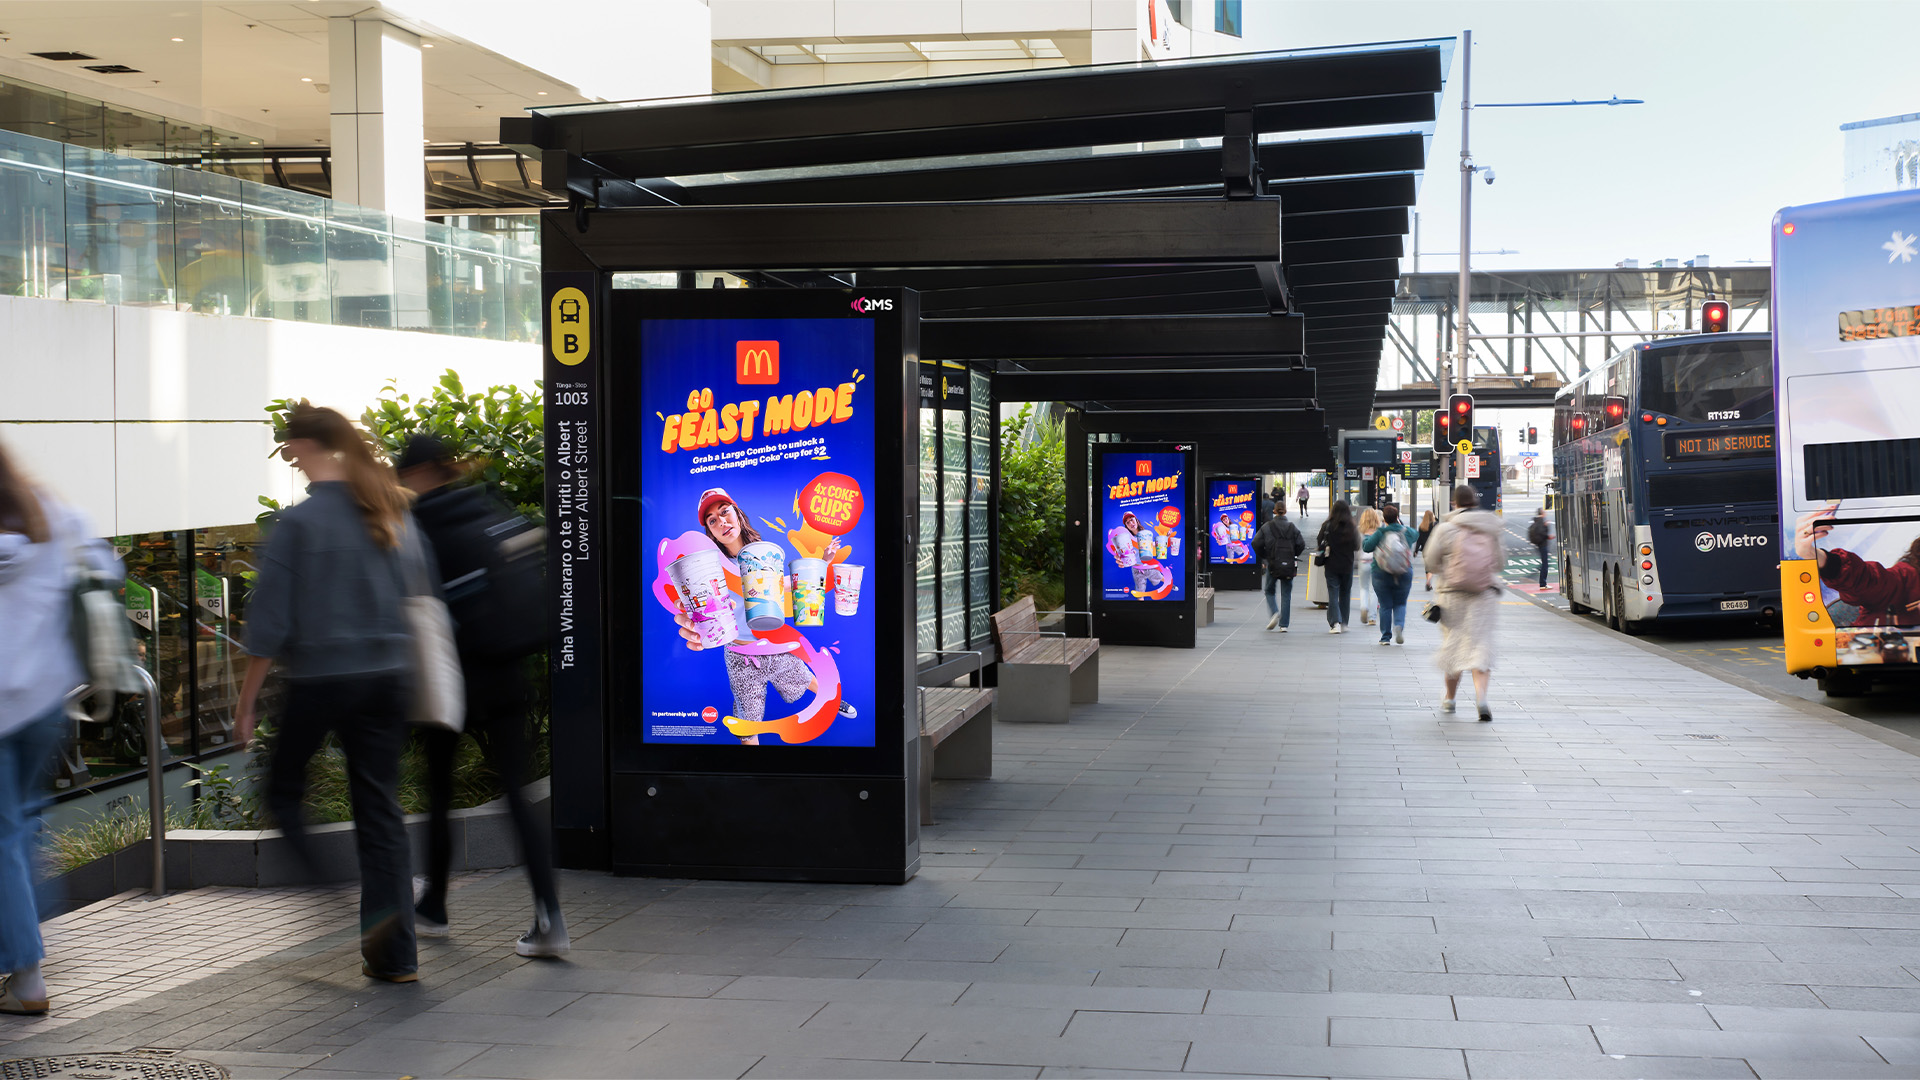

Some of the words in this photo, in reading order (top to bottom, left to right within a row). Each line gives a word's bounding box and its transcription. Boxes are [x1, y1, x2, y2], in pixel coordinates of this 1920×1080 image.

[858, 297, 893, 313] QMS
[1874, 307, 1908, 323] Join
[1845, 323, 1888, 340] 0800
[564, 334, 579, 353] B
[555, 392, 588, 405] 1003
[687, 387, 714, 412] GO
[661, 400, 760, 454] FEAST
[763, 382, 856, 437] MODE
[1707, 410, 1740, 420] RT1375
[558, 420, 571, 466] Albert
[575, 420, 588, 464] Street
[693, 452, 713, 464] Grab
[721, 450, 745, 460] Large
[746, 445, 776, 456] Combo
[778, 443, 787, 451] to
[789, 437, 817, 449] unlock
[1461, 443, 1468, 451] B
[1680, 439, 1701, 453] NOT
[1707, 438, 1719, 451] IN
[1724, 435, 1771, 451] SERVICE
[690, 457, 758, 475] colour-changing
[784, 450, 800, 461] cup
[801, 448, 813, 457] for
[814, 446, 827, 456] $2
[561, 470, 571, 480] o
[575, 467, 588, 512] Albert
[814, 482, 827, 496] 4x
[1109, 481, 1145, 500] FEAST
[1145, 475, 1178, 494] MODE
[558, 484, 571, 517] Tiriti
[810, 495, 852, 521] CUPS
[560, 521, 572, 535] te
[821, 516, 843, 527] COLLECT
[562, 539, 572, 549] o
[576, 516, 589, 560] Lower
[1717, 533, 1767, 548] Metro
[560, 553, 573, 632] Whakararo
[207, 599, 220, 608] 05
[136, 611, 149, 620] 04
[561, 636, 574, 670] Taha
